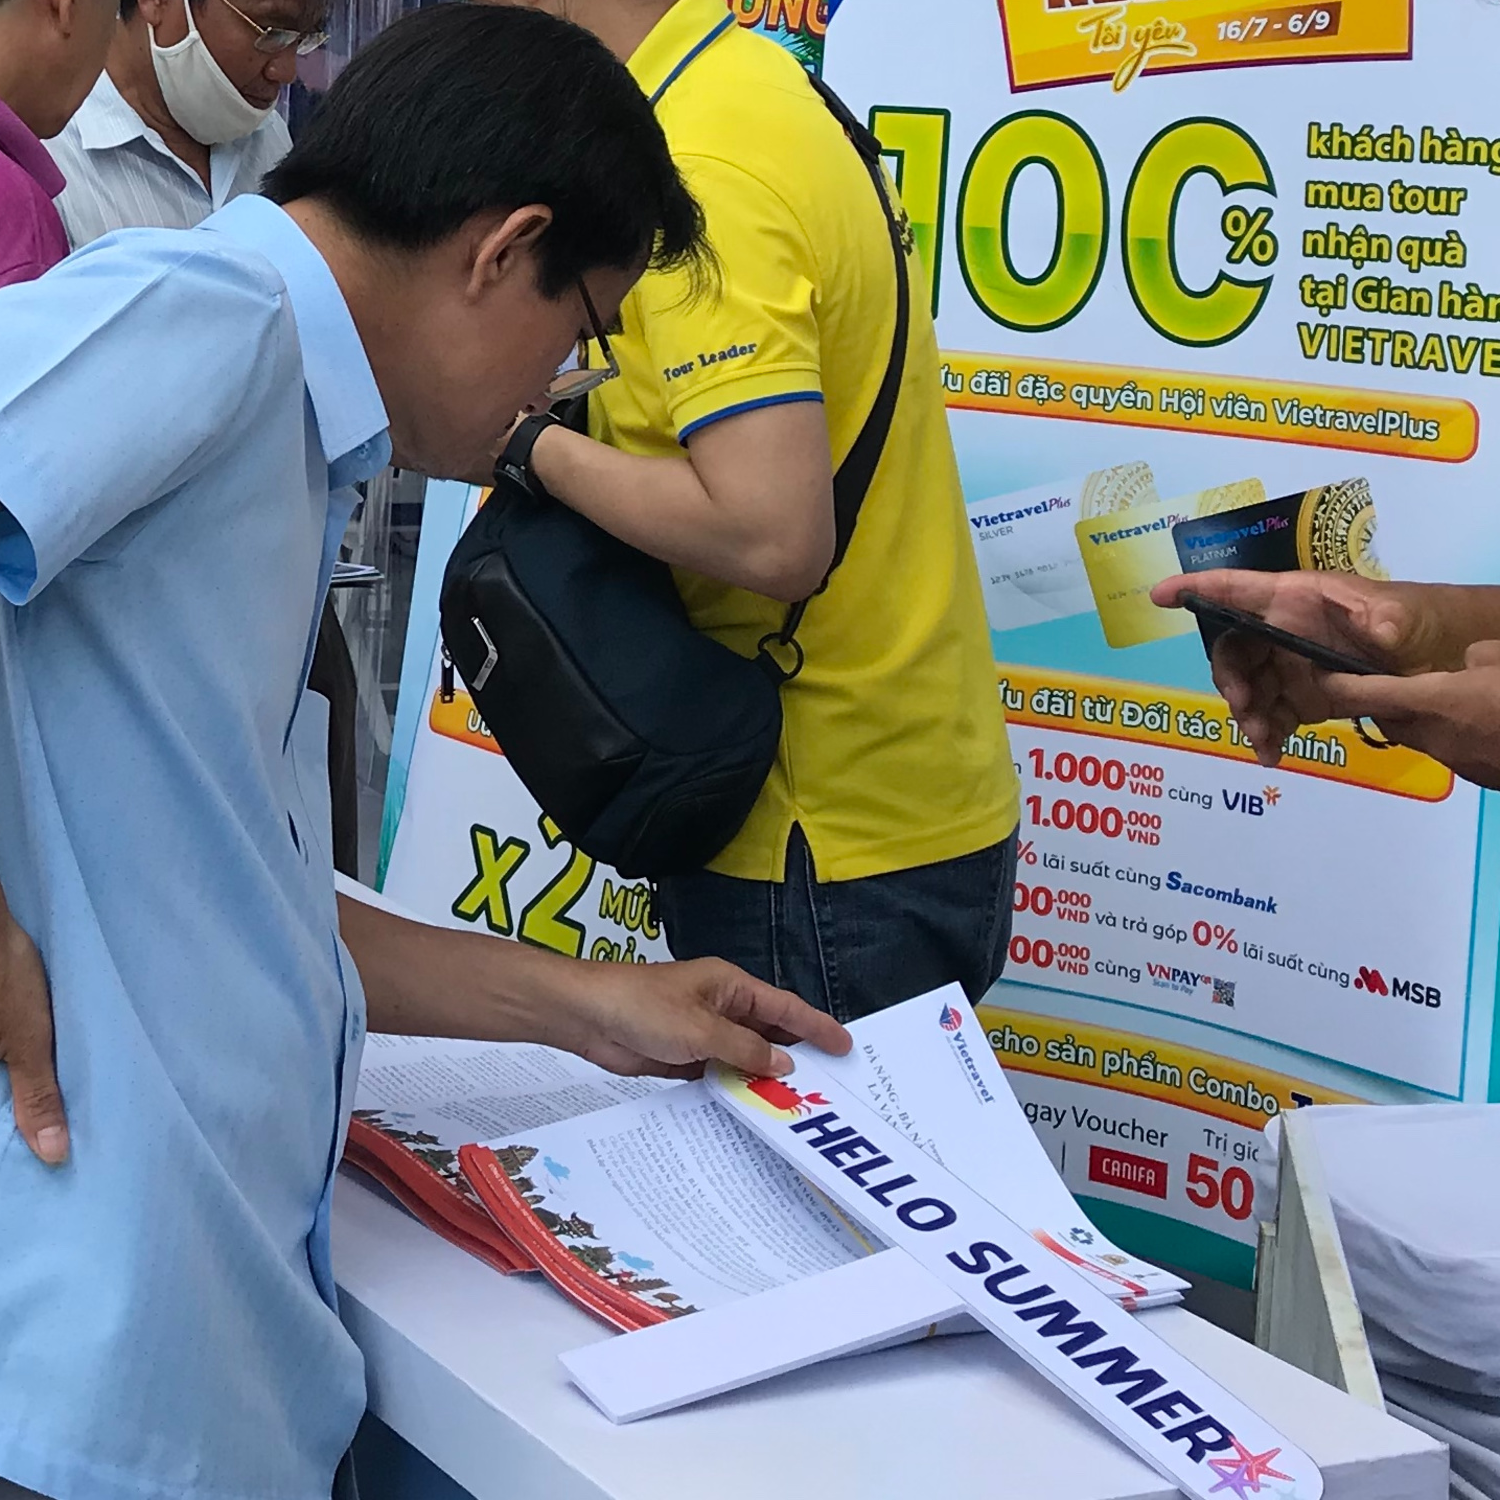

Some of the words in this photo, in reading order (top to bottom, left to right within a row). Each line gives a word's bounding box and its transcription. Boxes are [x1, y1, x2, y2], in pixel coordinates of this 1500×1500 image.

[1217, 14, 1267, 41] 16/7
[1287, 9, 1331, 36] 6/9
[1078, 6, 1124, 52] Tôi
[1113, 17, 1197, 92] yêu
[1308, 122, 1414, 162] khách
[1305, 180, 1383, 212] mua
[1388, 179, 1467, 216] tour
[1303, 222, 1392, 269] nhận
[1397, 229, 1467, 273] quà
[1300, 273, 1348, 317] tại
[1352, 276, 1432, 317] Gian
[663, 361, 695, 383] Tour
[697, 343, 758, 368] Leader
[969, 368, 1010, 398] đãi
[1016, 373, 1066, 406] đặc
[1071, 379, 1153, 419] quyền
[1159, 387, 1207, 420] Hội
[1211, 391, 1267, 423] viên
[1272, 398, 1441, 442] VietravelPlus
[970, 496, 1072, 531] VietravelPlus
[978, 526, 1016, 543] SILVER
[1190, 546, 1239, 565] PLATINUM
[1031, 688, 1074, 718] đãi
[1081, 696, 1115, 724] từ
[1120, 700, 1171, 734] Đối
[1176, 710, 1222, 742] tác
[1128, 781, 1163, 799] VND
[1168, 785, 1213, 810] cùng
[1222, 788, 1265, 817] VIB
[1126, 828, 1161, 847] VND
[1042, 853, 1066, 871] lãi
[1070, 859, 1111, 880] suất
[1114, 864, 1162, 891] cùng
[1166, 871, 1279, 915] Sacombank
[1056, 907, 1090, 924] VND
[1095, 911, 1118, 928] và
[1122, 915, 1148, 933] trả
[1152, 923, 1188, 944] góp
[1192, 920, 1240, 954] 0%
[1243, 941, 1264, 962] lãi
[1267, 950, 1304, 973] suất
[1307, 961, 1351, 989] cùng
[1391, 976, 1442, 1009] MSB
[1056, 958, 1089, 976] VND
[1094, 958, 1142, 984] cùng
[953, 1030, 996, 1104] Vietravel
[987, 1026, 1039, 1057] cho
[1045, 1034, 1095, 1068] sản
[1102, 1048, 1182, 1088] phẩm
[1187, 1068, 1281, 1116] Combo
[1020, 1102, 1068, 1129] gay
[1071, 1105, 1169, 1149] Voucher
[1203, 1127, 1229, 1157] Trị
[1101, 1157, 1156, 1187] CANIFA
[1185, 1151, 1256, 1222] 50
[789, 1110, 958, 1233] HELLO
[945, 1240, 1237, 1465] SUMMER
